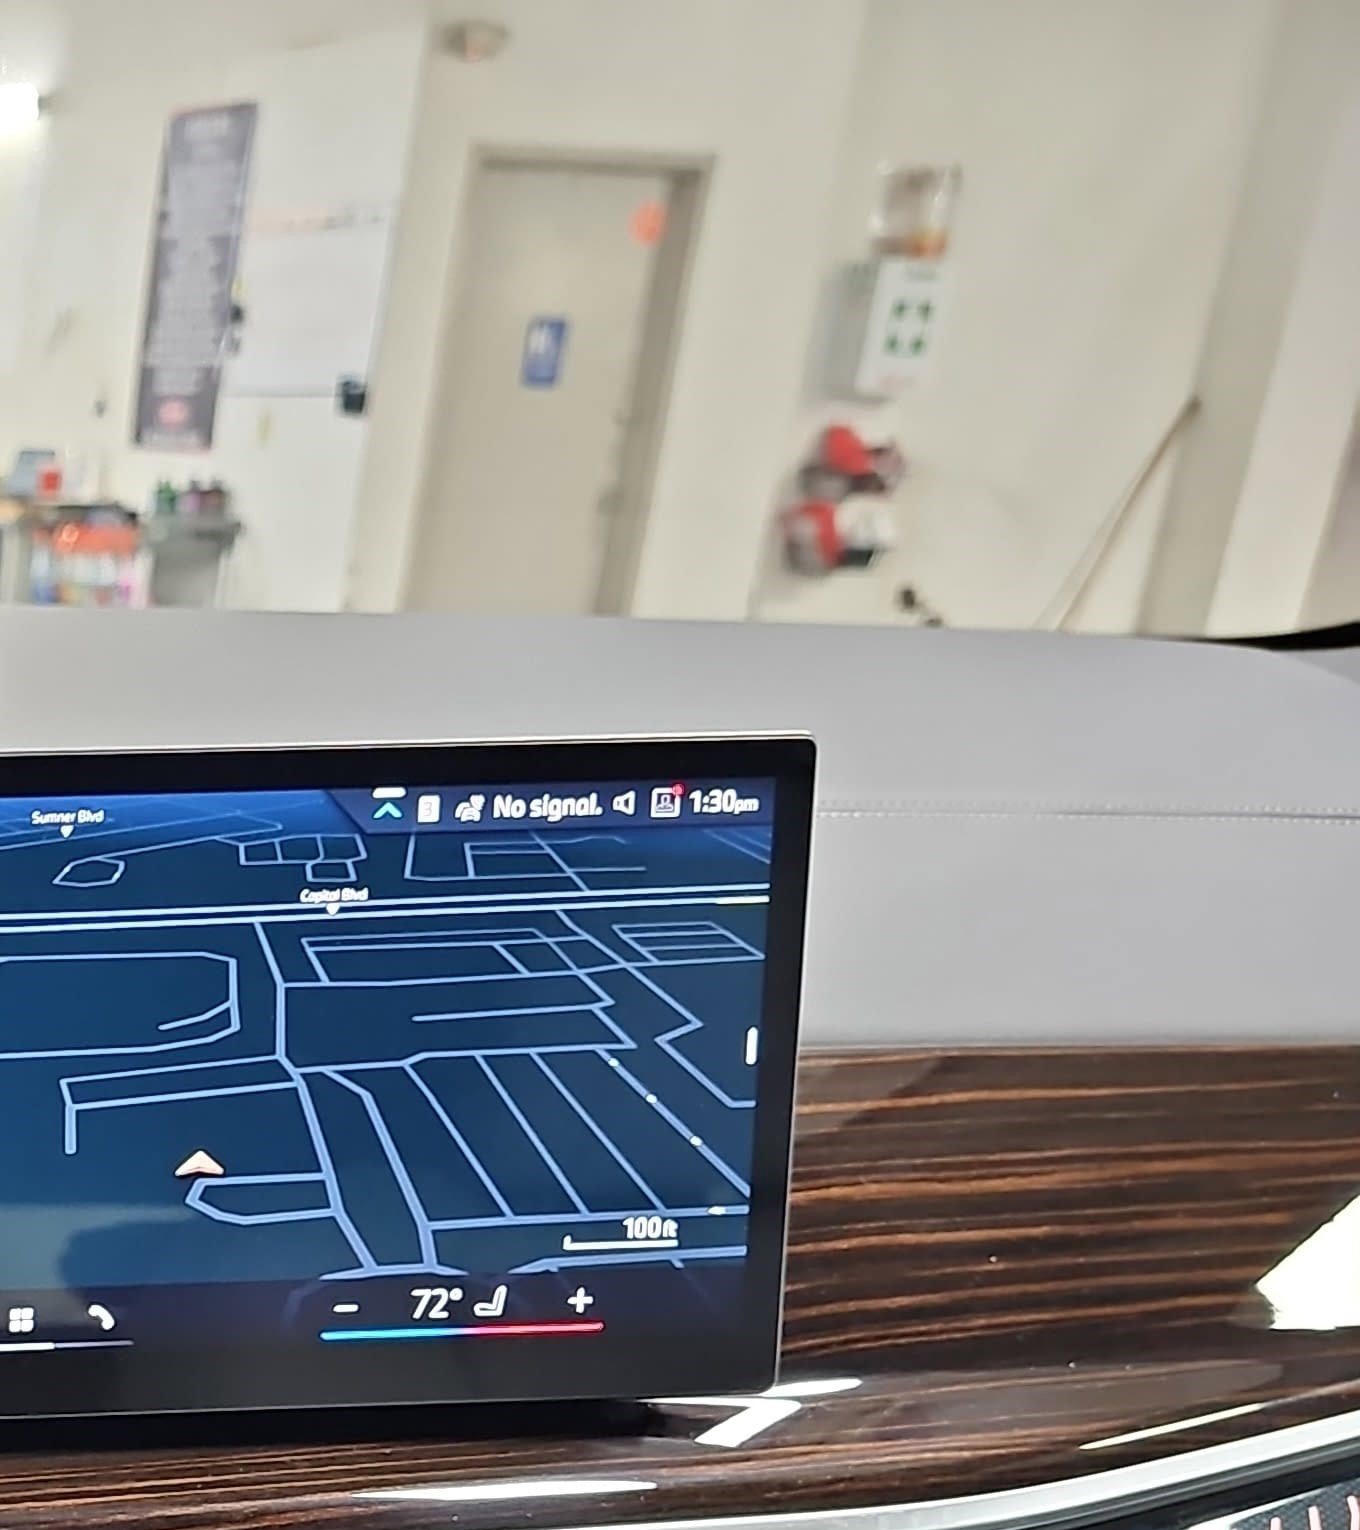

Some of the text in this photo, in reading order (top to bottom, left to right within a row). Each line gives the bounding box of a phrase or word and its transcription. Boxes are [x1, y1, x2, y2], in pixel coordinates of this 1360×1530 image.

[493, 793, 603, 822] No signal.
[689, 789, 759, 814] 1:30pm
[32, 809, 105, 824] Sumner Blvd
[300, 887, 369, 904] Capital Blvd
[411, 1287, 463, 1319] 72°
